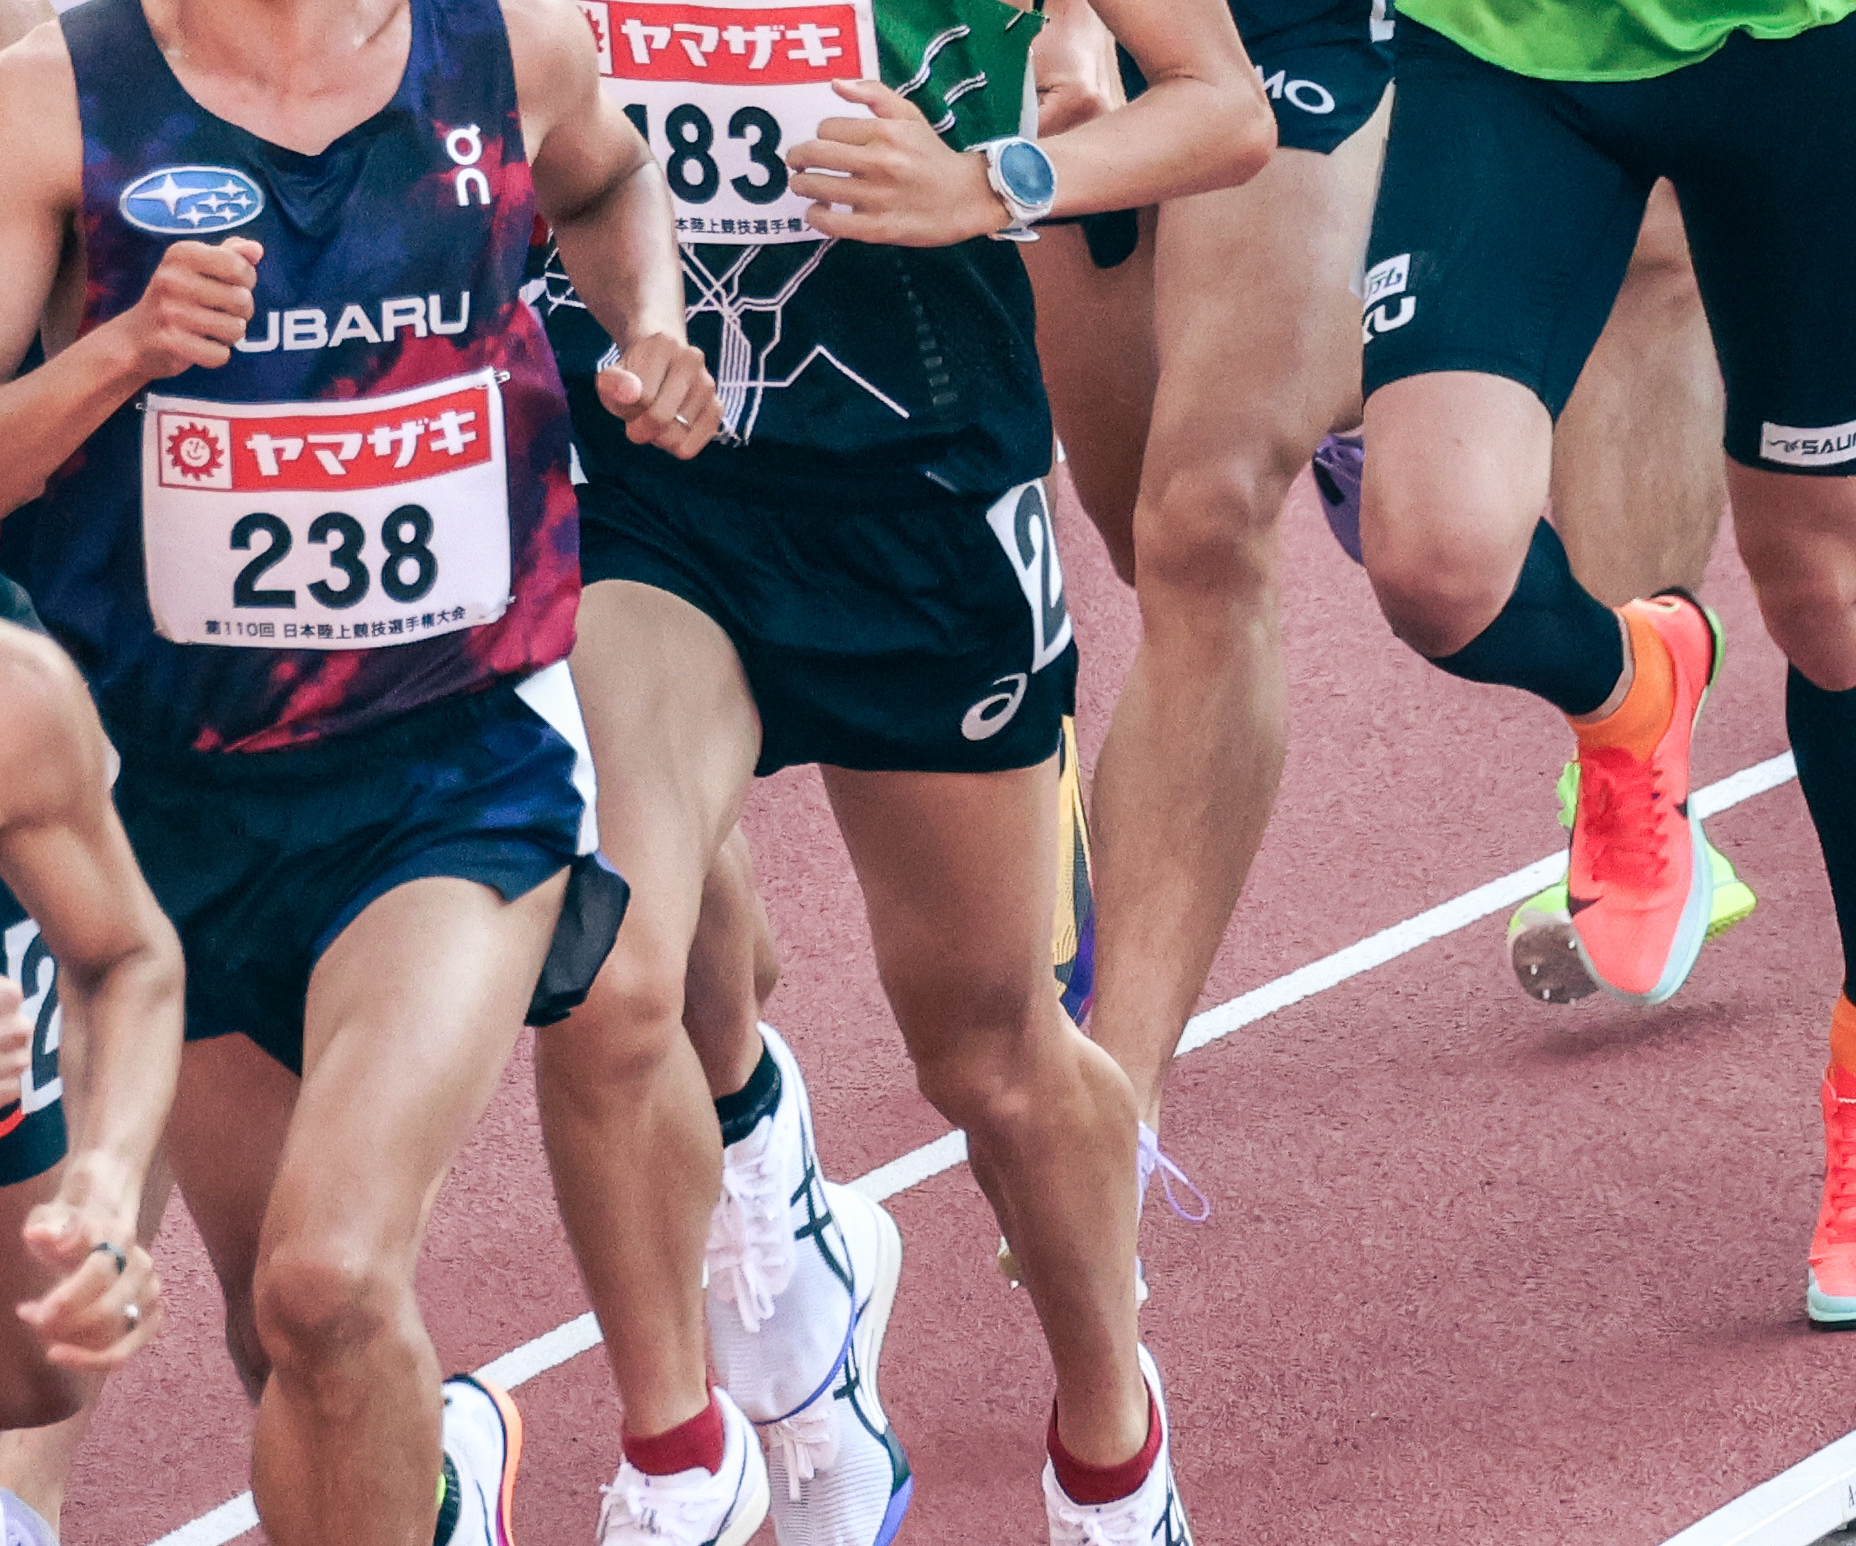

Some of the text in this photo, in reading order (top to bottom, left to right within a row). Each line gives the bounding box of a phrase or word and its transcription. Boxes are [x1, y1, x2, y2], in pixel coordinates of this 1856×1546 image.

[621, 19, 843, 70] ヤマザキ
[675, 218, 813, 235] 本陸上競技選手権
[245, 410, 478, 476] ヤマザキ
[230, 504, 439, 610] 238
[205, 605, 467, 640] 第110回 日本陸上競技選手権大会
